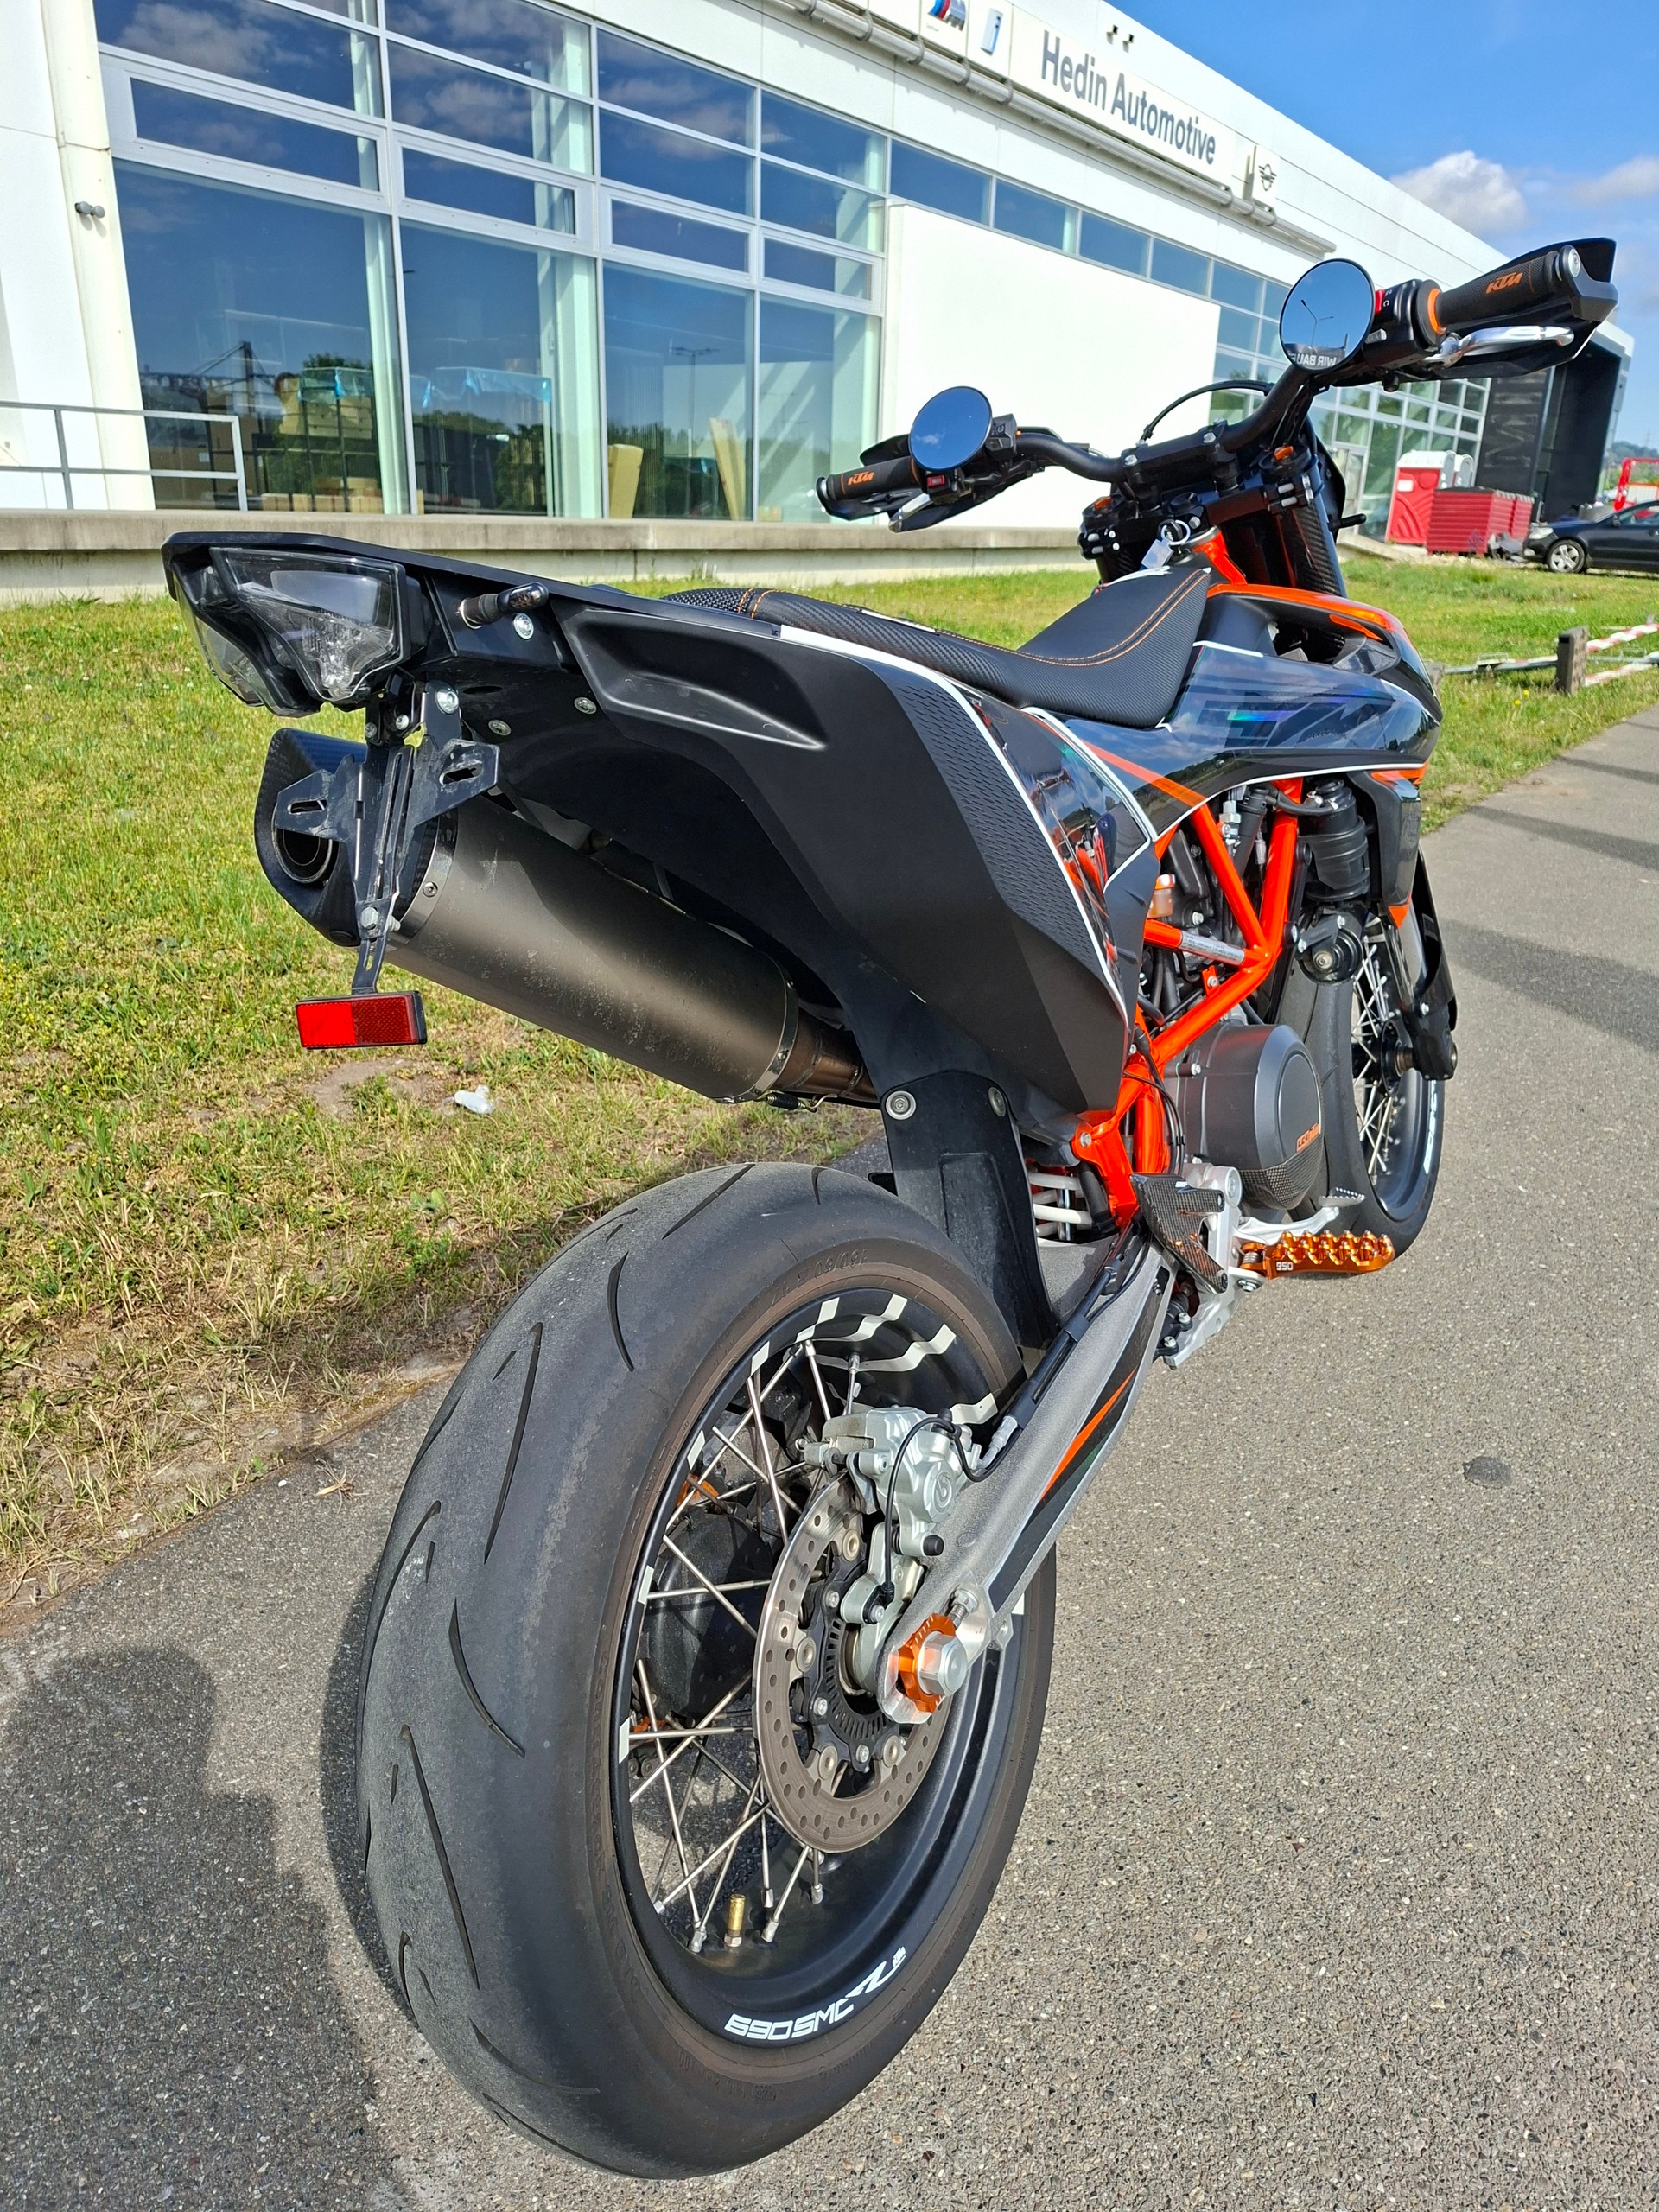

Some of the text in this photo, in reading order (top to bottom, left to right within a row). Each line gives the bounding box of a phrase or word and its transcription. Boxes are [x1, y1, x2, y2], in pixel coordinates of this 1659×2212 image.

[1042, 30, 1216, 165] Hedin Automotive
[1485, 271, 1523, 295] KTM
[848, 471, 875, 486] KTM
